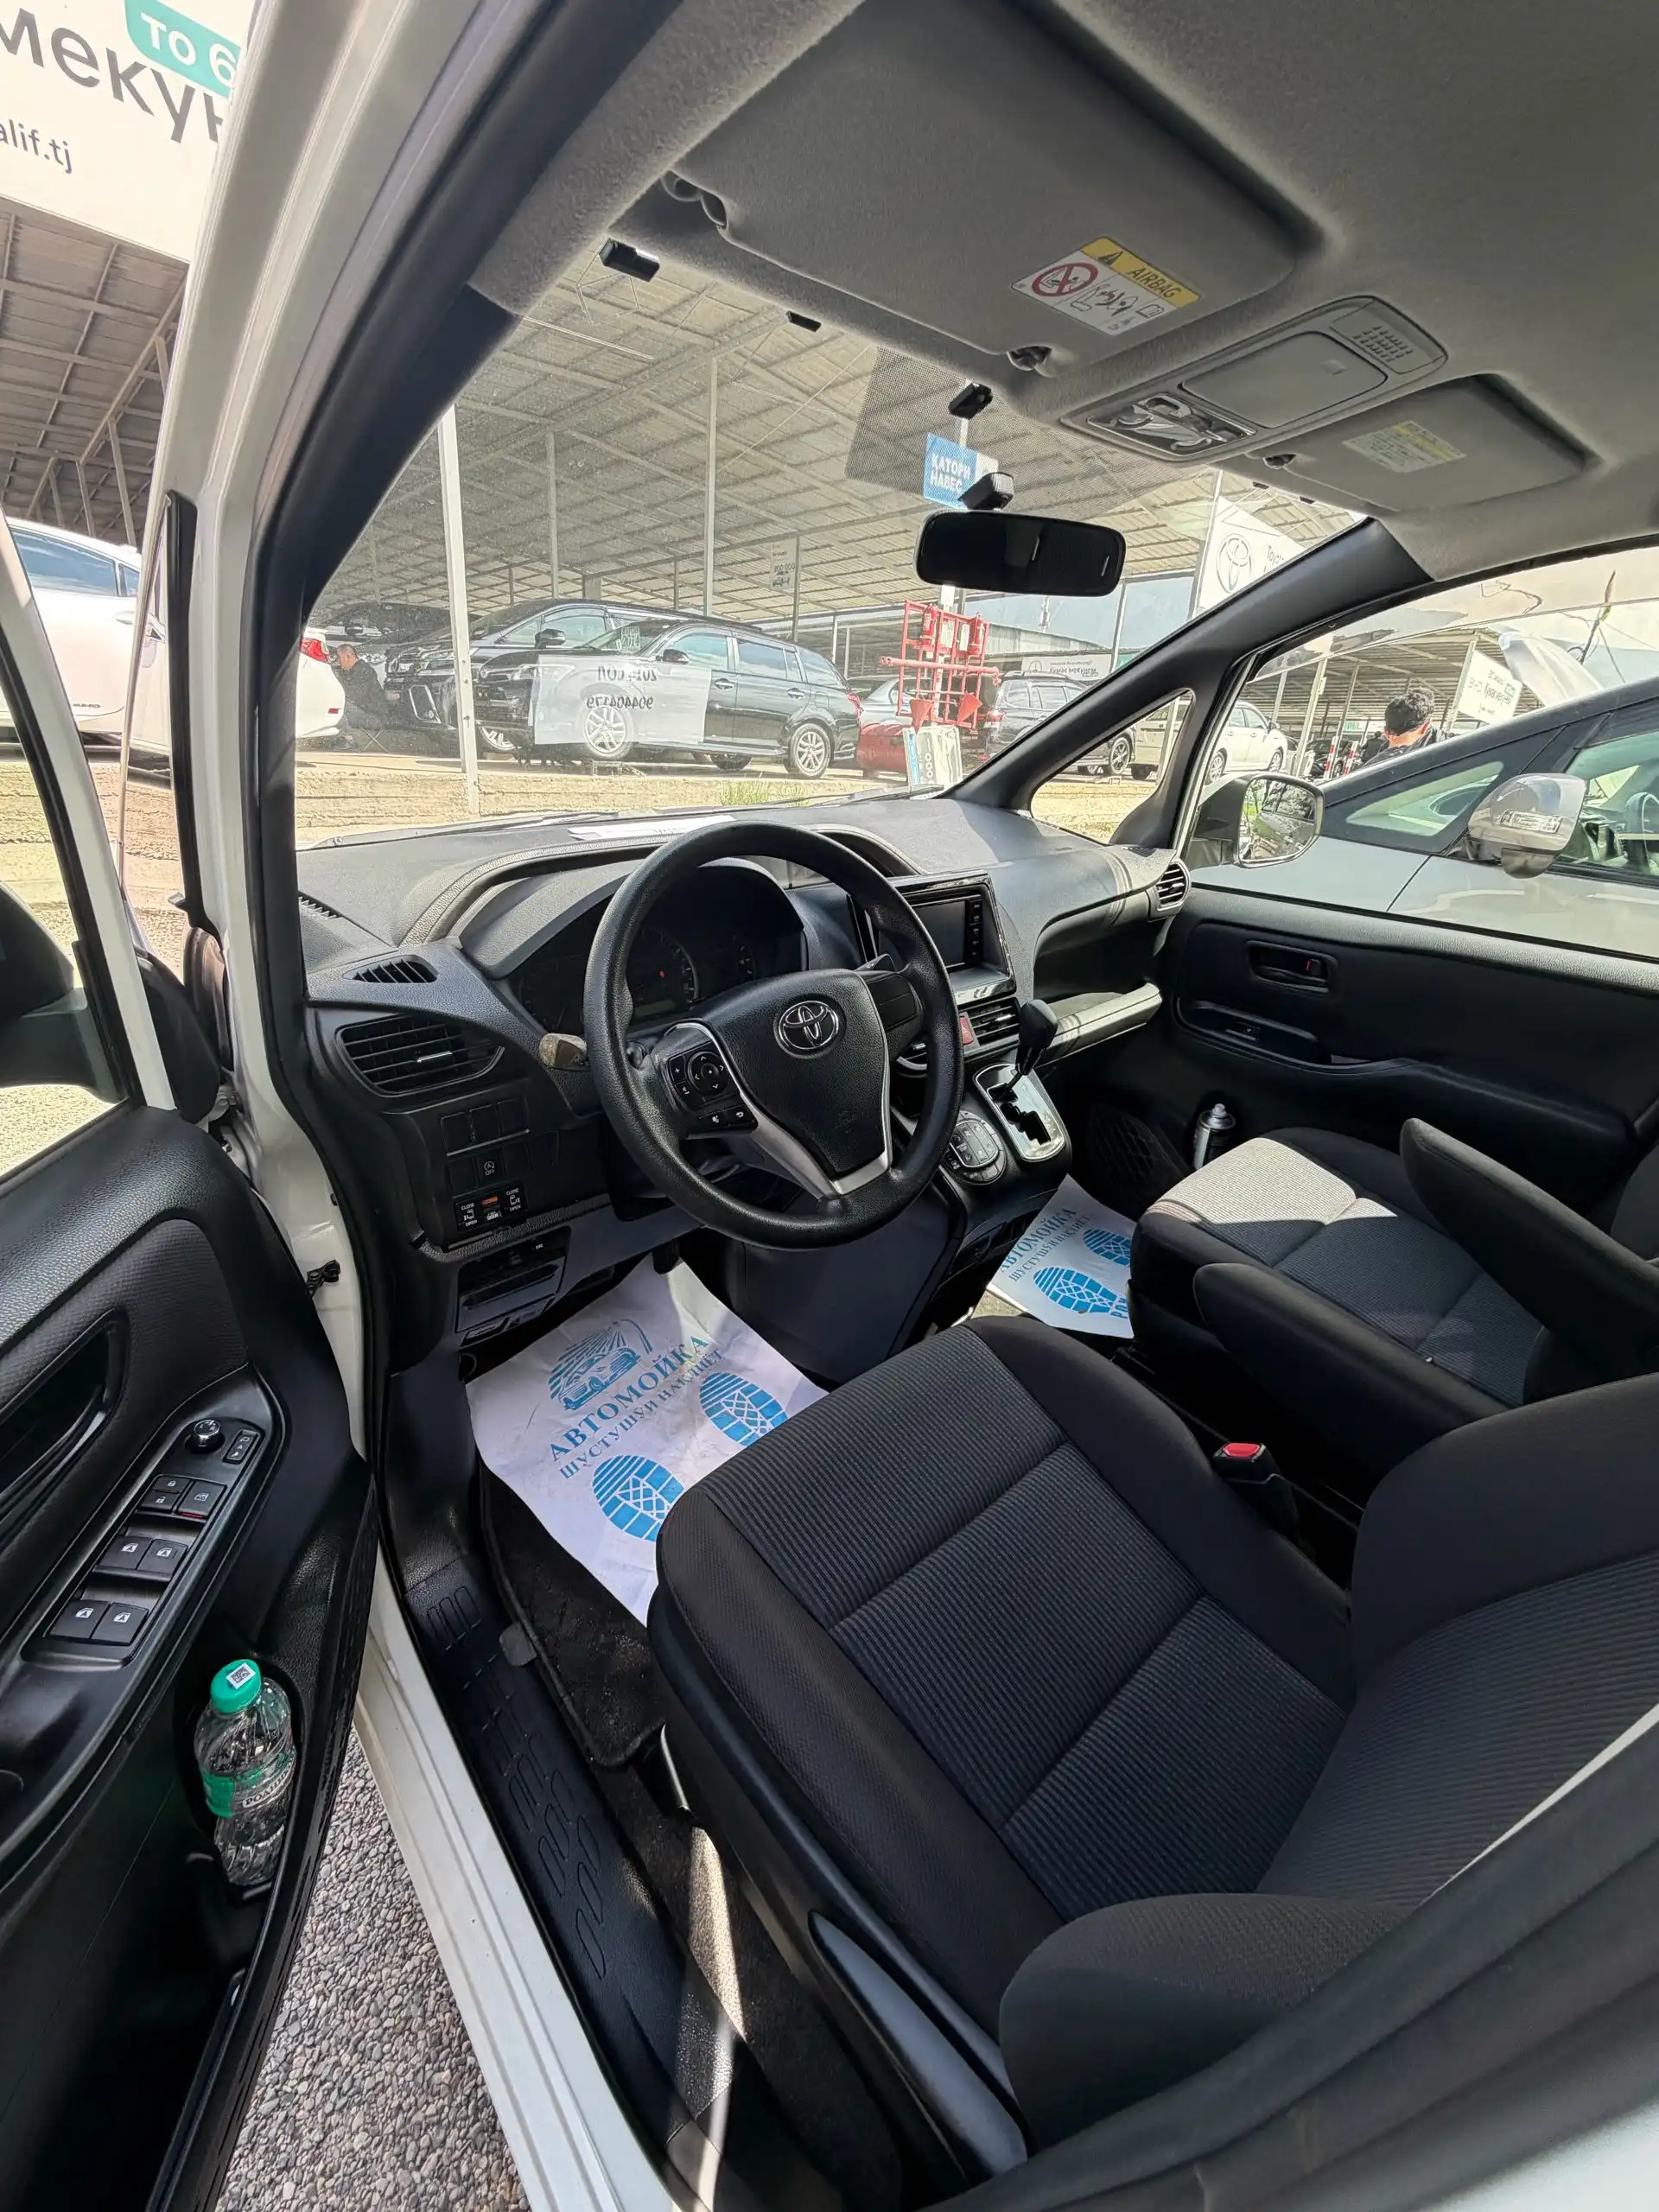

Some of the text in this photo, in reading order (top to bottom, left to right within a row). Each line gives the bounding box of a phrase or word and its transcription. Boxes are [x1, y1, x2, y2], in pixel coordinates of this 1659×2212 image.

[1128, 268, 1182, 298] AIRBAG
[1000, 1208, 1077, 1274] АВТОМОЙКА
[550, 1336, 709, 1461] АВТОМОЙКА
